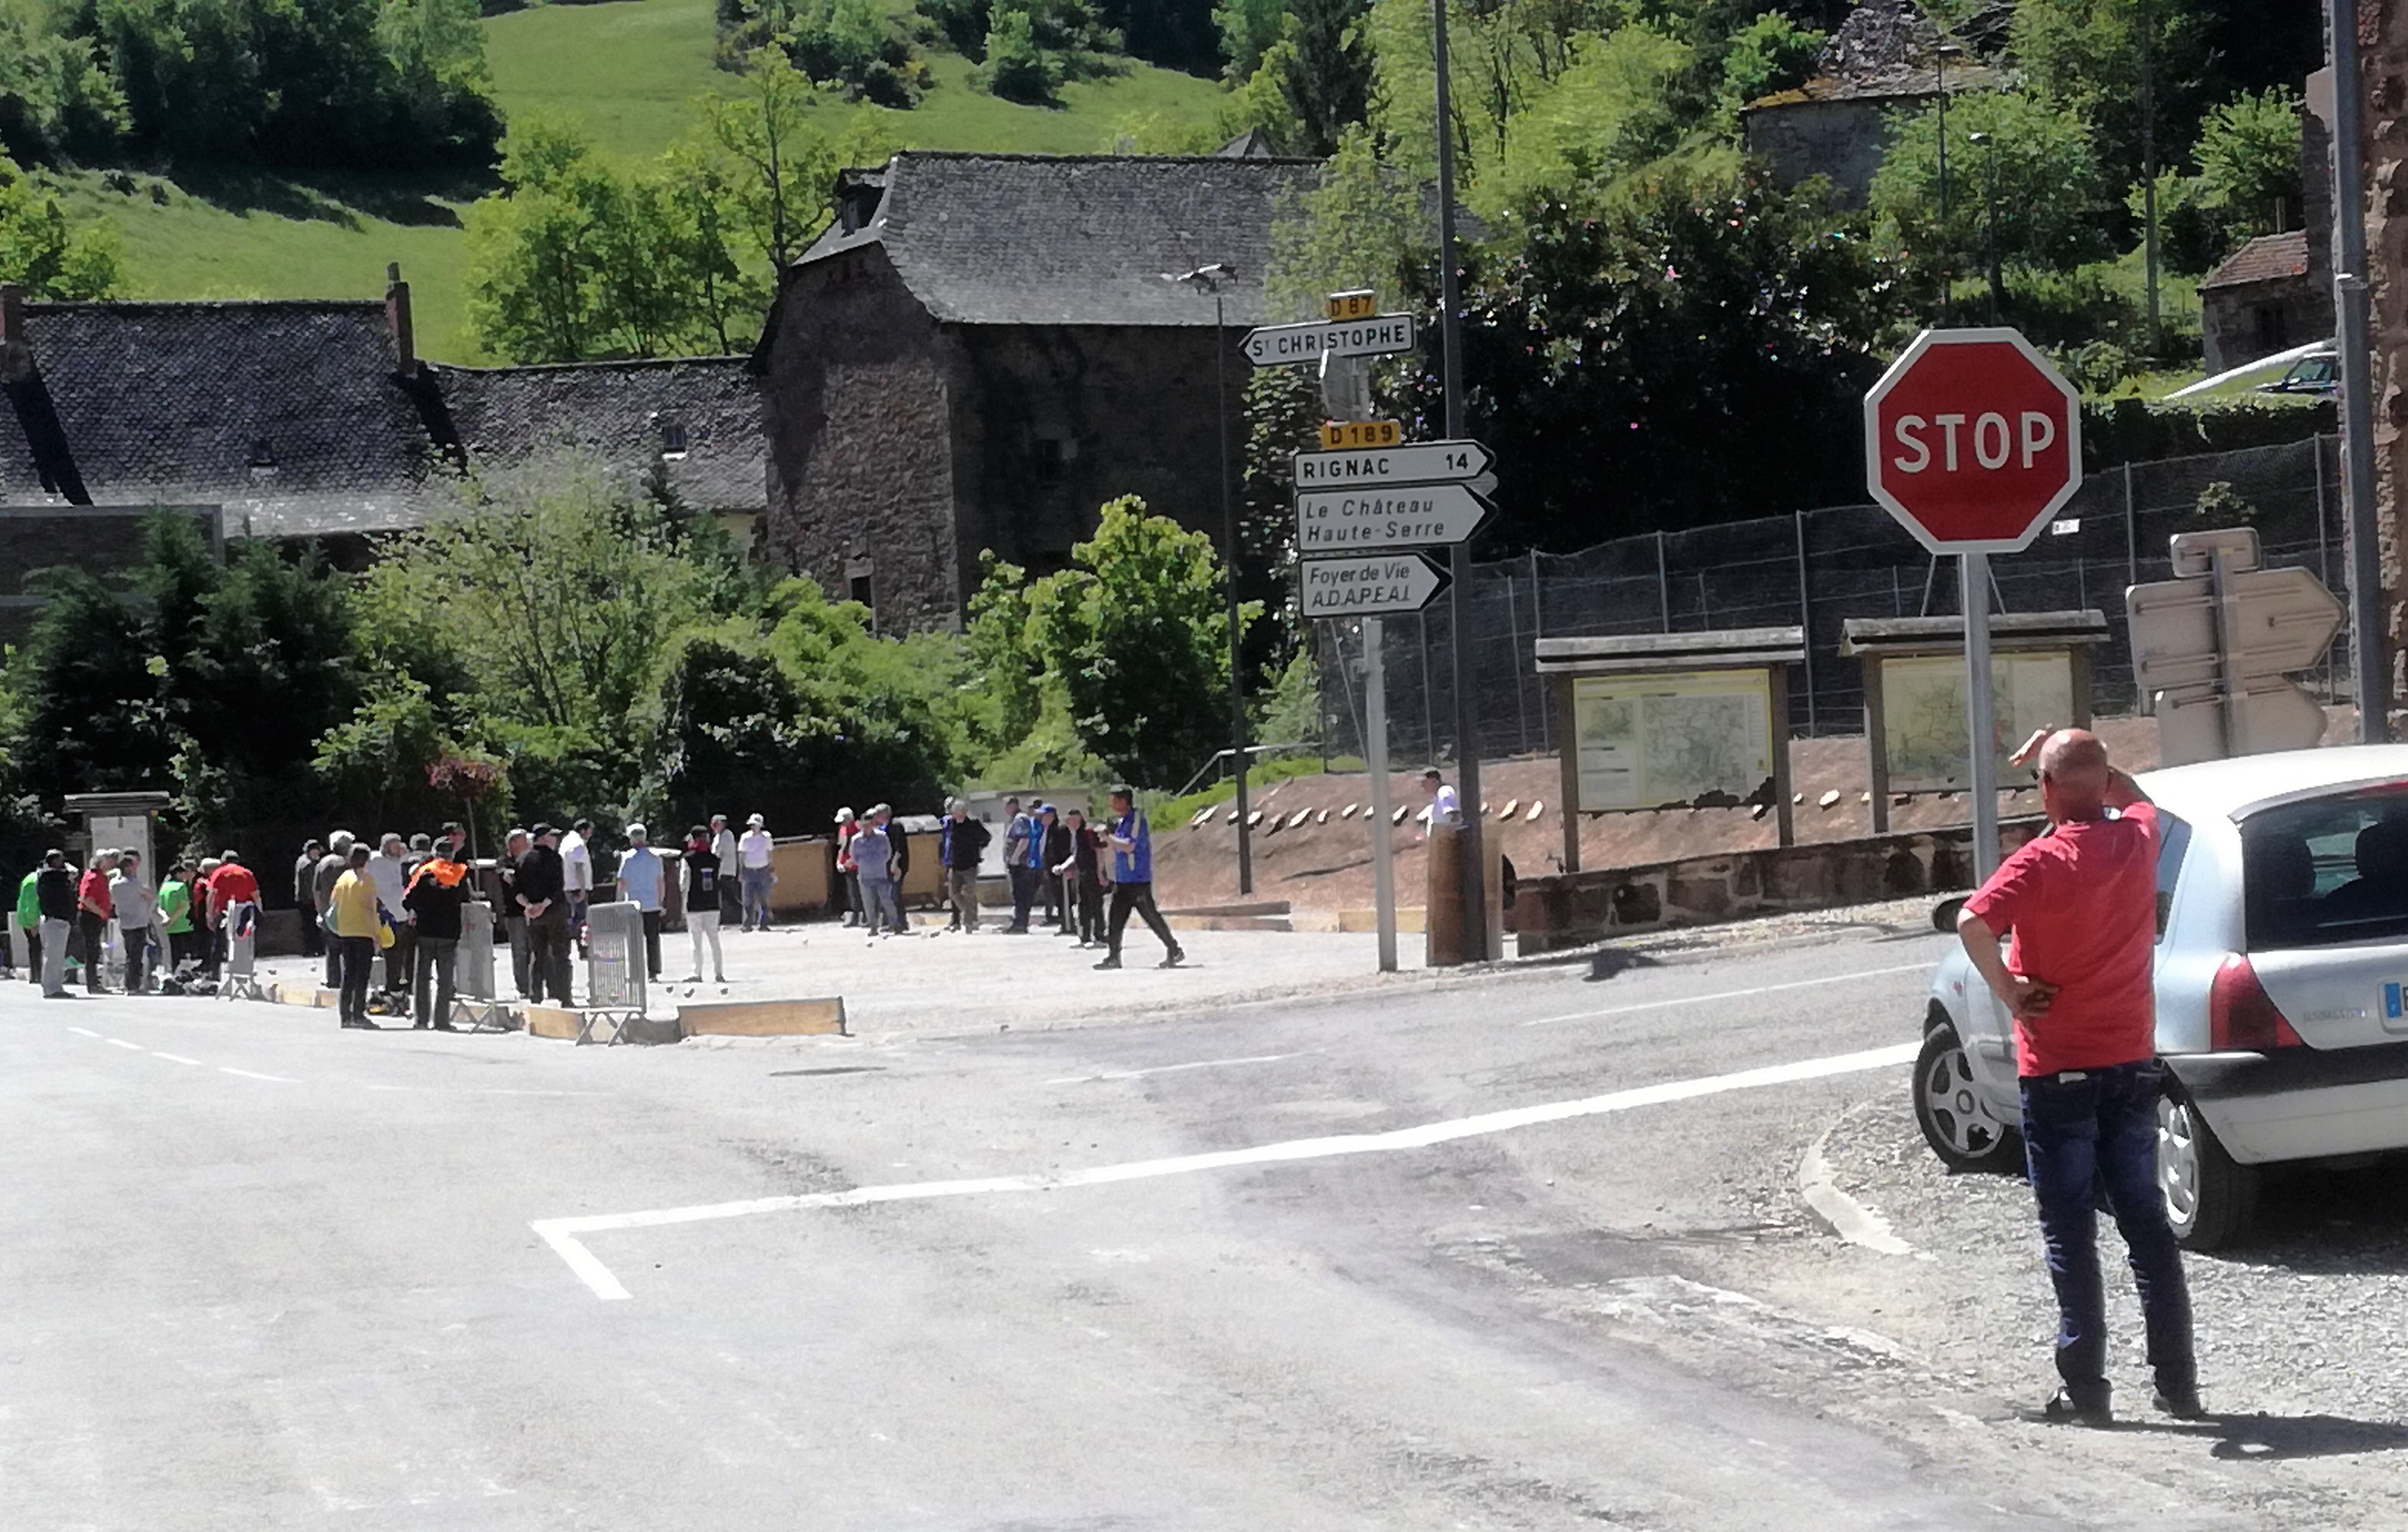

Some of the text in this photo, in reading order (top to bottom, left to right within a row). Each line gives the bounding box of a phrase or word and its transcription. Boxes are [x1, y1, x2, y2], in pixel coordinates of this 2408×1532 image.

[1331, 296, 1373, 316] D 87
[1278, 325, 1405, 354] CHRISTOPHE
[1331, 425, 1393, 444] D 189
[1894, 410, 2055, 474] STOP
[1303, 453, 1469, 478] RIGNAC 14
[1305, 498, 1434, 519] Le Château
[1307, 520, 1445, 543] Haute-Serre
[1310, 561, 1410, 587] Foyer de Vie
